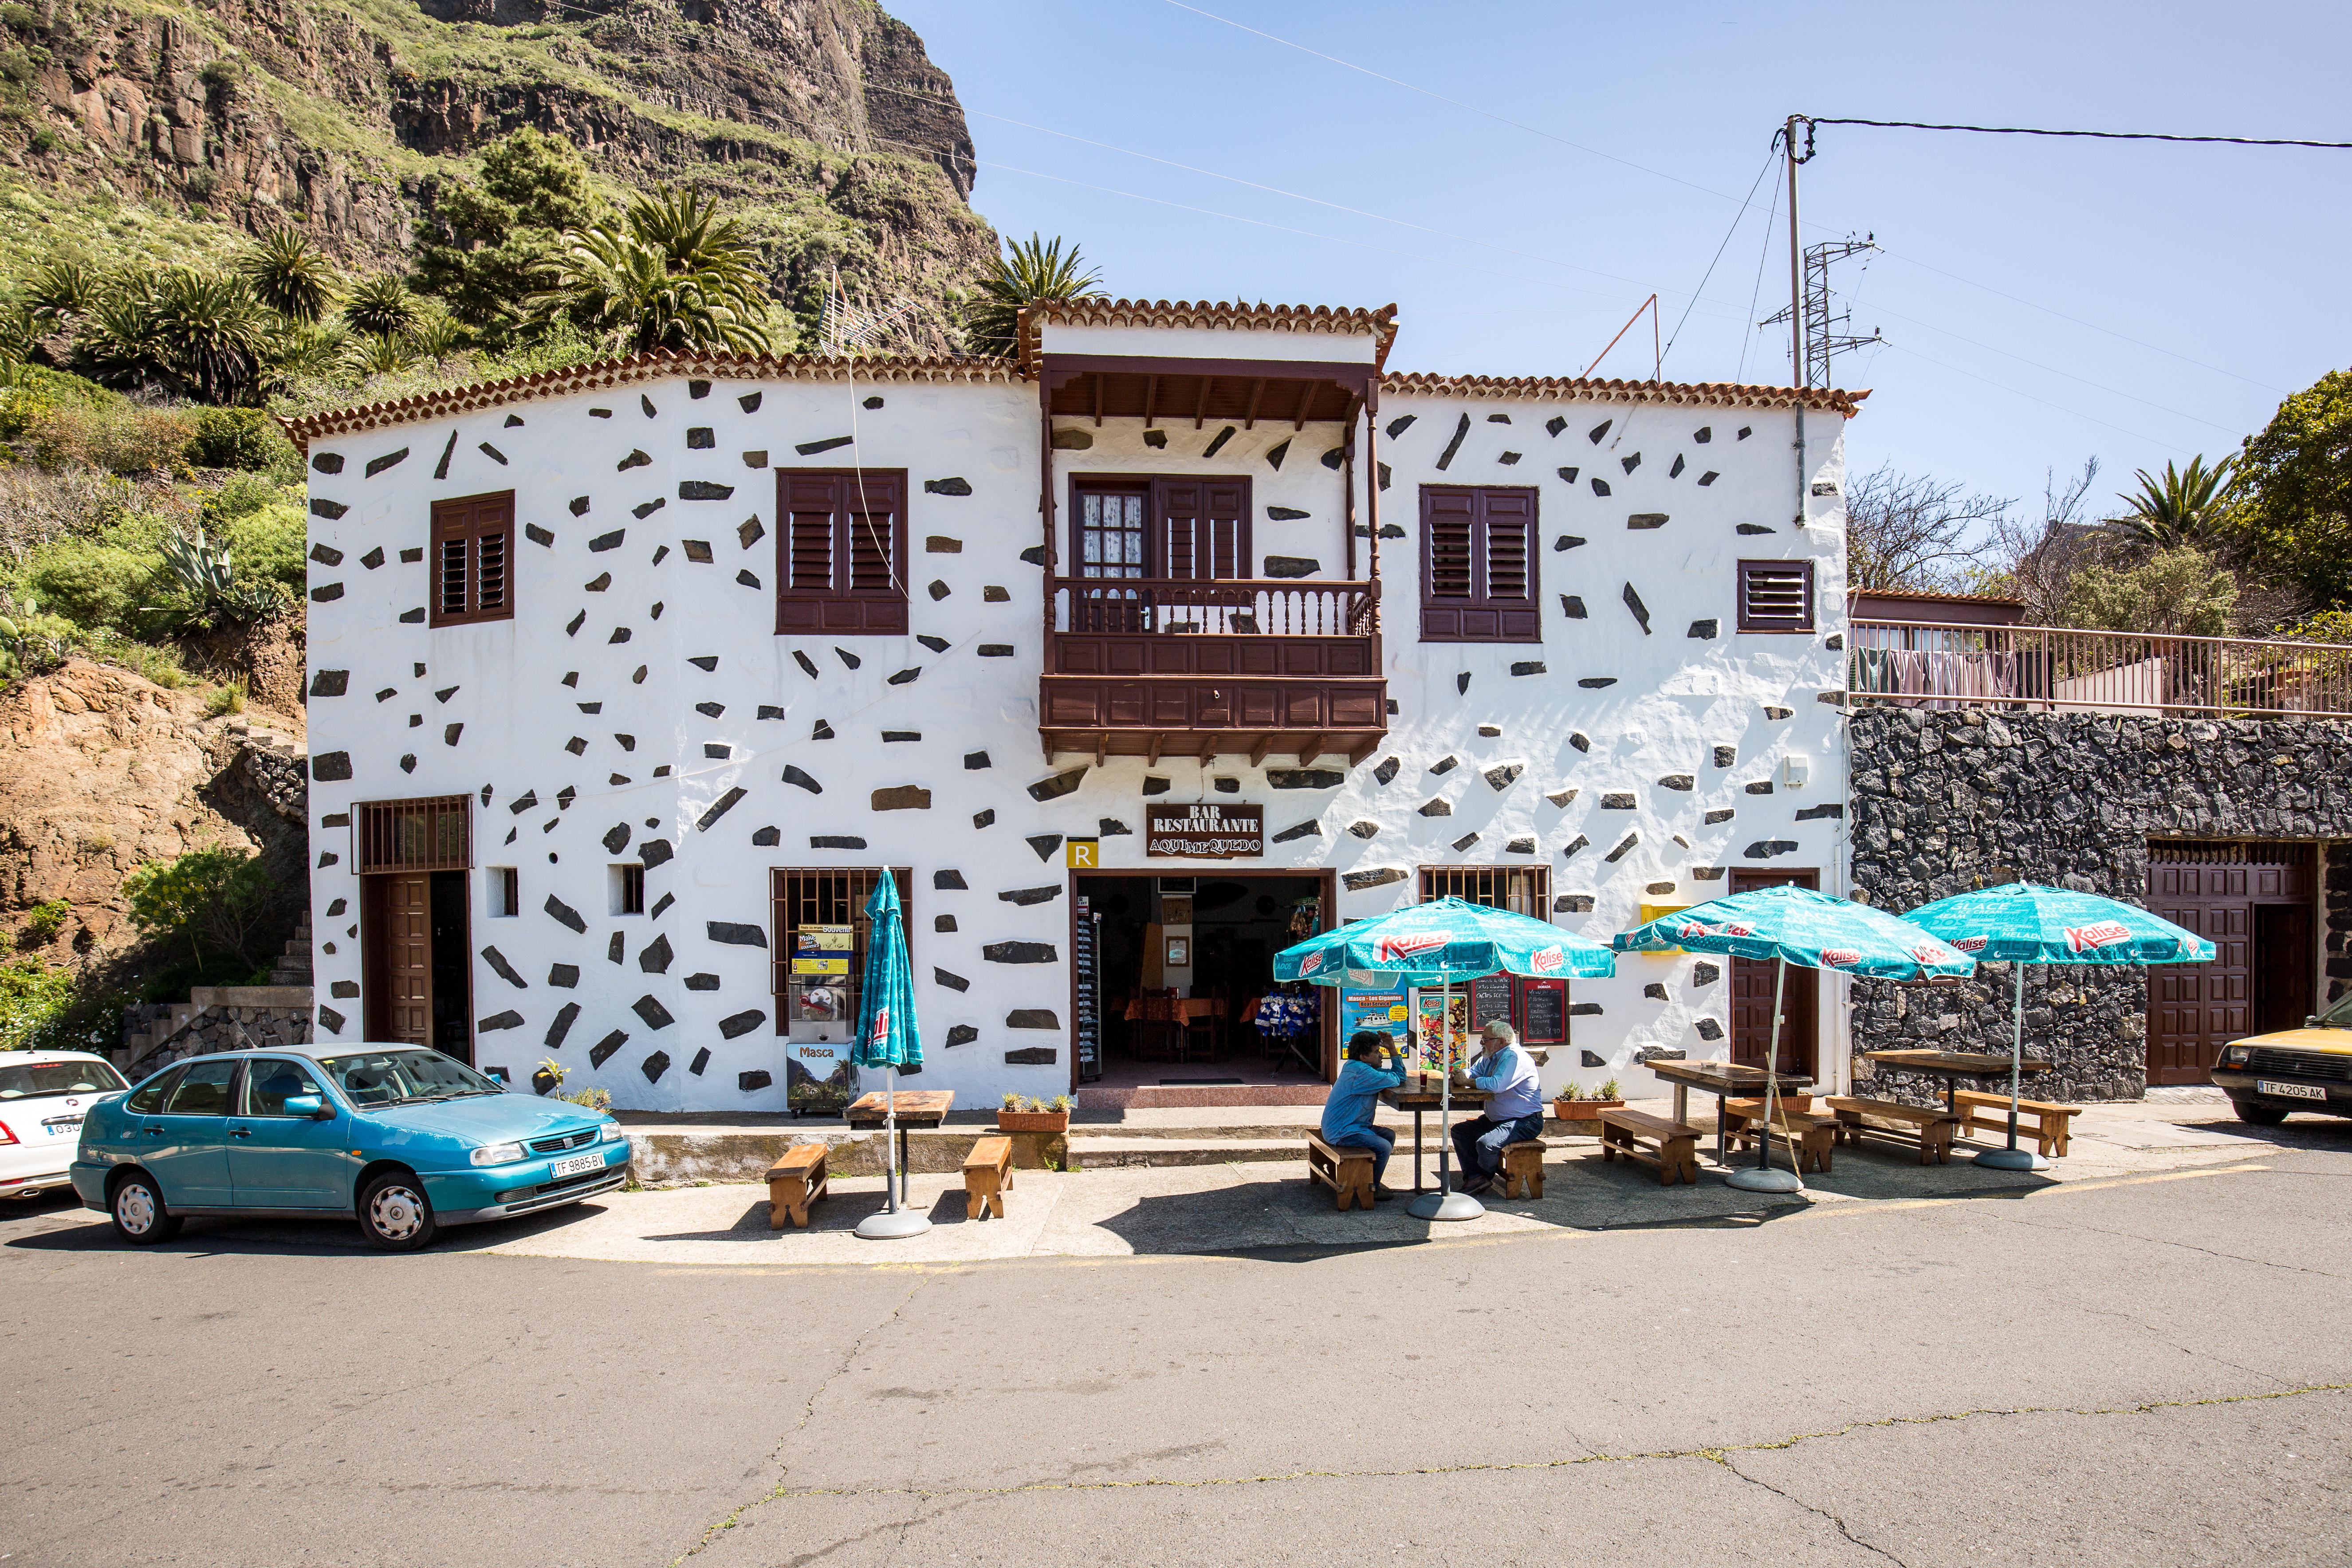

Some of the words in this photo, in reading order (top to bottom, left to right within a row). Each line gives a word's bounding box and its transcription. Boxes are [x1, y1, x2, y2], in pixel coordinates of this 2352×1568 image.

[1190, 806, 1221, 819] BAR
[1153, 819, 1258, 832] RESTAURANTE
[1150, 839, 1188, 854] AQUI
[1186, 842, 1209, 853] ME
[1209, 838, 1261, 854] QUEDO
[1076, 845, 1092, 865] R
[2065, 926, 2128, 953] Kalise
[1381, 935, 1451, 962] Kalise
[1300, 952, 1323, 976] Kalise
[1533, 950, 1563, 973] Kalise
[1821, 947, 1861, 967] Kalise
[1424, 998, 1441, 1008] Kalise
[1545, 1026, 1561, 1035] 9.90
[800, 1047, 834, 1057] Masca
[2264, 1082, 2277, 1092] TF
[2279, 1085, 2307, 1096] 4205
[2310, 1088, 2324, 1099] AK
[56, 1124, 82, 1133] 030
[556, 1162, 566, 1174] TF
